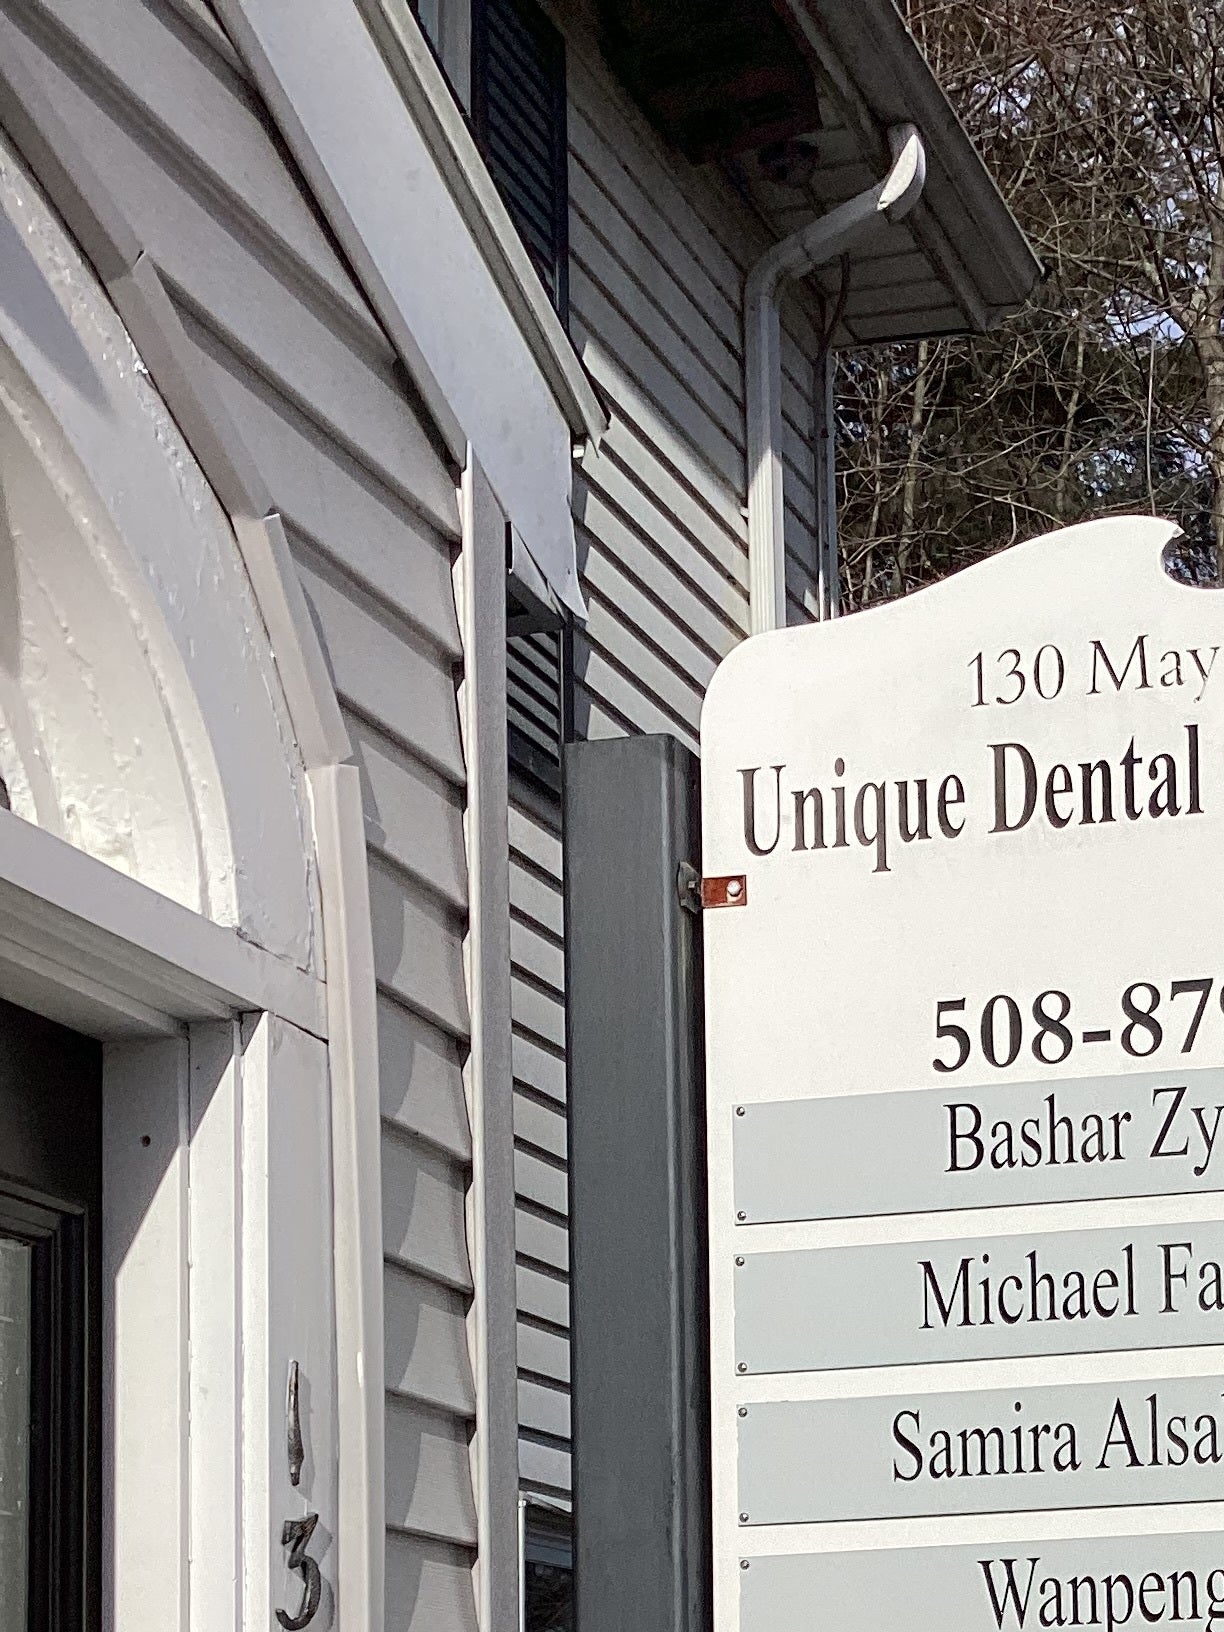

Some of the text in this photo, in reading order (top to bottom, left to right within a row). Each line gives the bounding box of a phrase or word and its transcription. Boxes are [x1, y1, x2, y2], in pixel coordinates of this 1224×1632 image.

[968, 645, 1064, 707] 130
[737, 758, 965, 873] Unique
[987, 724, 1204, 833] Dental
[943, 1094, 1131, 1172] Bashar
[918, 1244, 1139, 1329] Michael
[893, 1402, 1081, 1481] Samira
